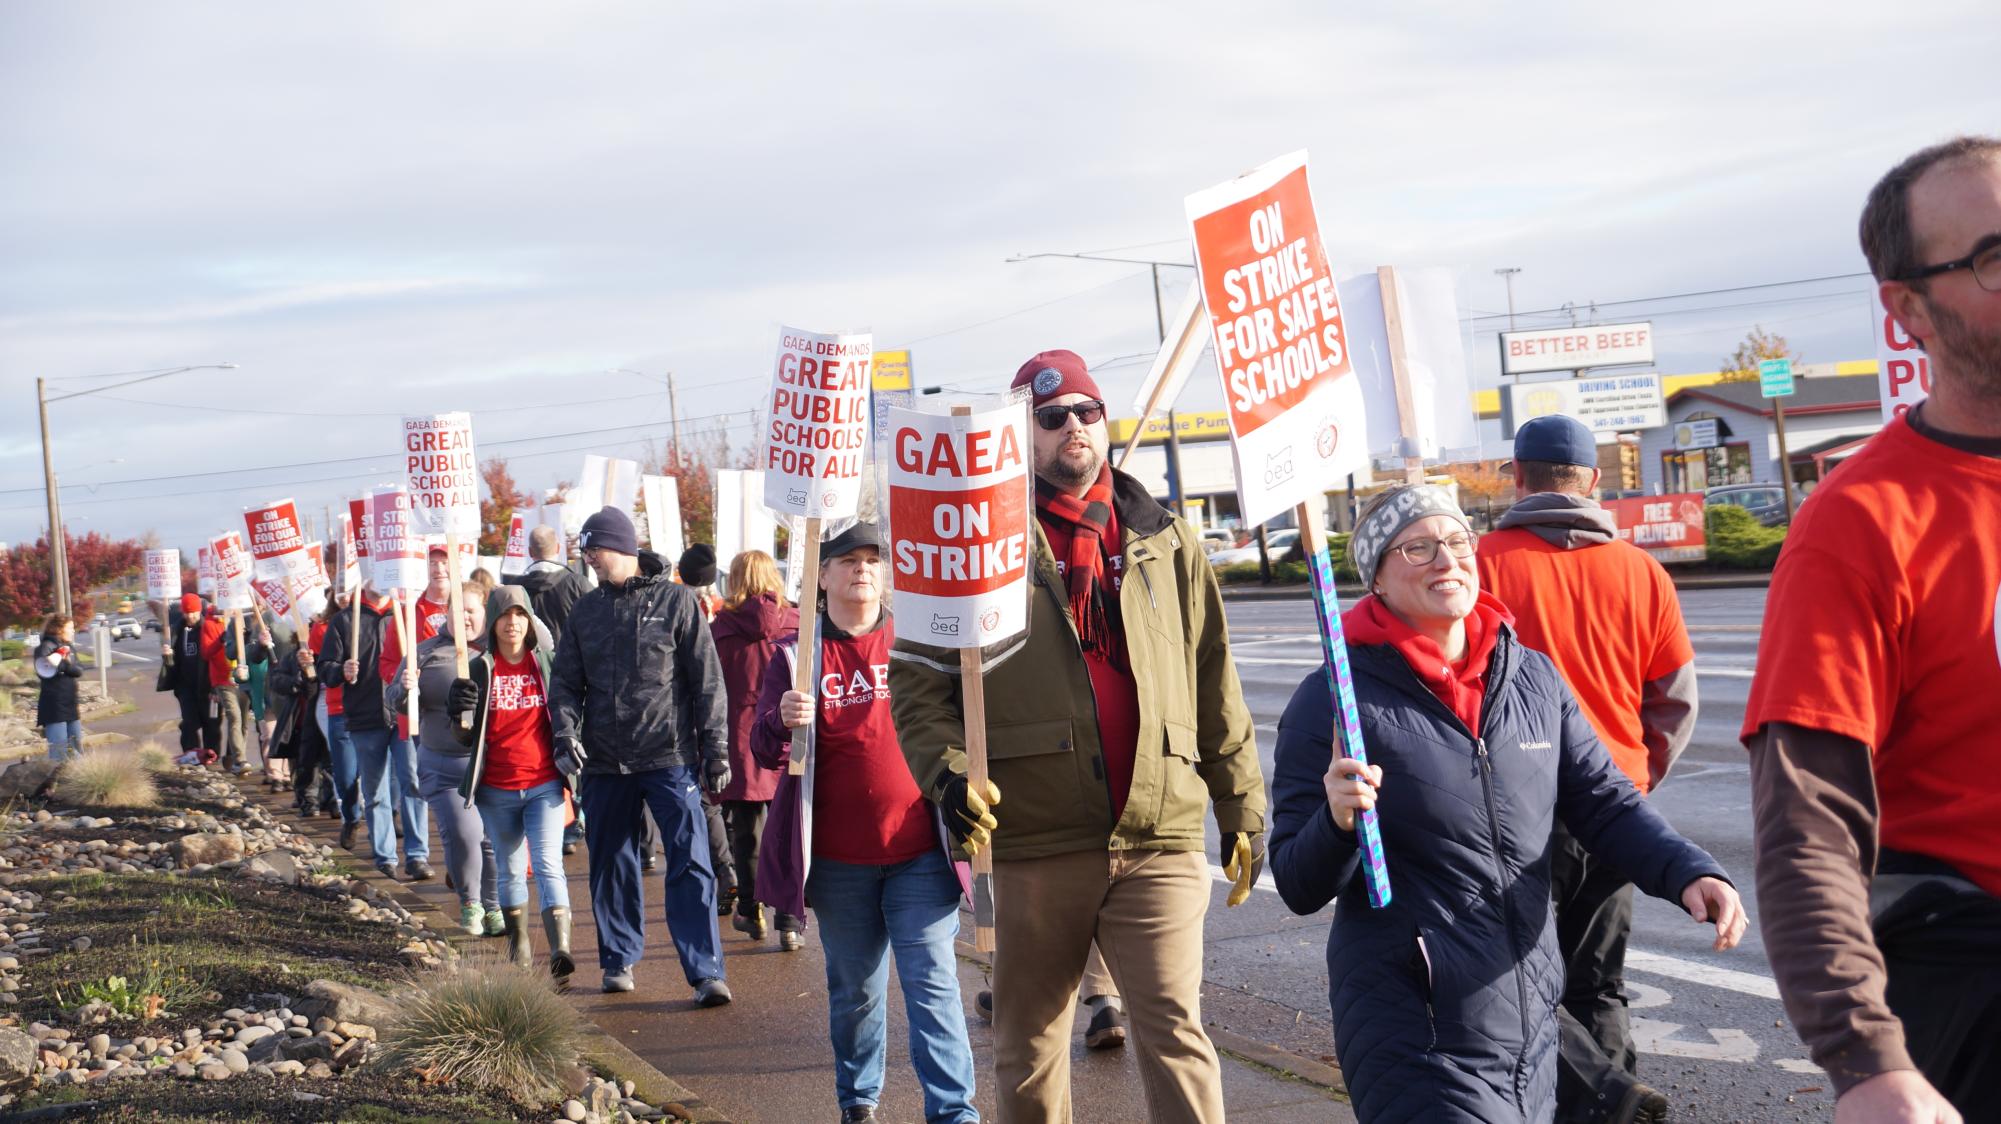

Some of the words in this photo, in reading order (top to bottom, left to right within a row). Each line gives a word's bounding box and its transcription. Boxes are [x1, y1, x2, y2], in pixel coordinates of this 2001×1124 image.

[1249, 201, 1285, 254] ON
[1223, 236, 1313, 313] STRIKE
[1217, 307, 1279, 369] FOR
[1278, 276, 1338, 342] SAFE
[783, 335, 813, 353] GAEA
[816, 342, 870, 357] DEMANDS
[1510, 335, 1589, 357] BETTER
[1596, 330, 1648, 350] BEEF
[778, 352, 869, 391] GREAT
[1230, 323, 1343, 413] SCHOOLS
[1578, 380, 1617, 393] DRIVING
[1619, 377, 1656, 389] SCHOOL
[773, 387, 865, 424] PUBLIC
[406, 421, 430, 430] GAEA
[1196, 417, 1230, 429] Pum
[407, 429, 469, 452] GREAT
[771, 419, 864, 450] SCHOOLS
[896, 424, 1022, 477] GAEA
[408, 452, 473, 473] PUBLIC
[769, 445, 814, 478] FOR
[822, 454, 859, 479] ALL
[1264, 459, 1293, 485] oea
[410, 472, 474, 490] SCHOOLS
[410, 492, 446, 509] FOR
[451, 491, 476, 507] ALL
[787, 493, 806, 505] oea
[263, 510, 279, 520] ON
[933, 501, 990, 539] ON
[1643, 502, 1673, 523] FREE
[254, 532, 275, 544] FOR
[275, 526, 297, 539] OUR
[255, 517, 292, 533] STRIKE
[379, 524, 404, 538] FOR
[1632, 521, 1687, 544] DELIVERY
[253, 535, 303, 555] STUDENTS
[895, 532, 1025, 580] STRIKE
[931, 621, 959, 634] oea
[821, 664, 889, 699] GAE
[824, 693, 874, 710] STRONGER
